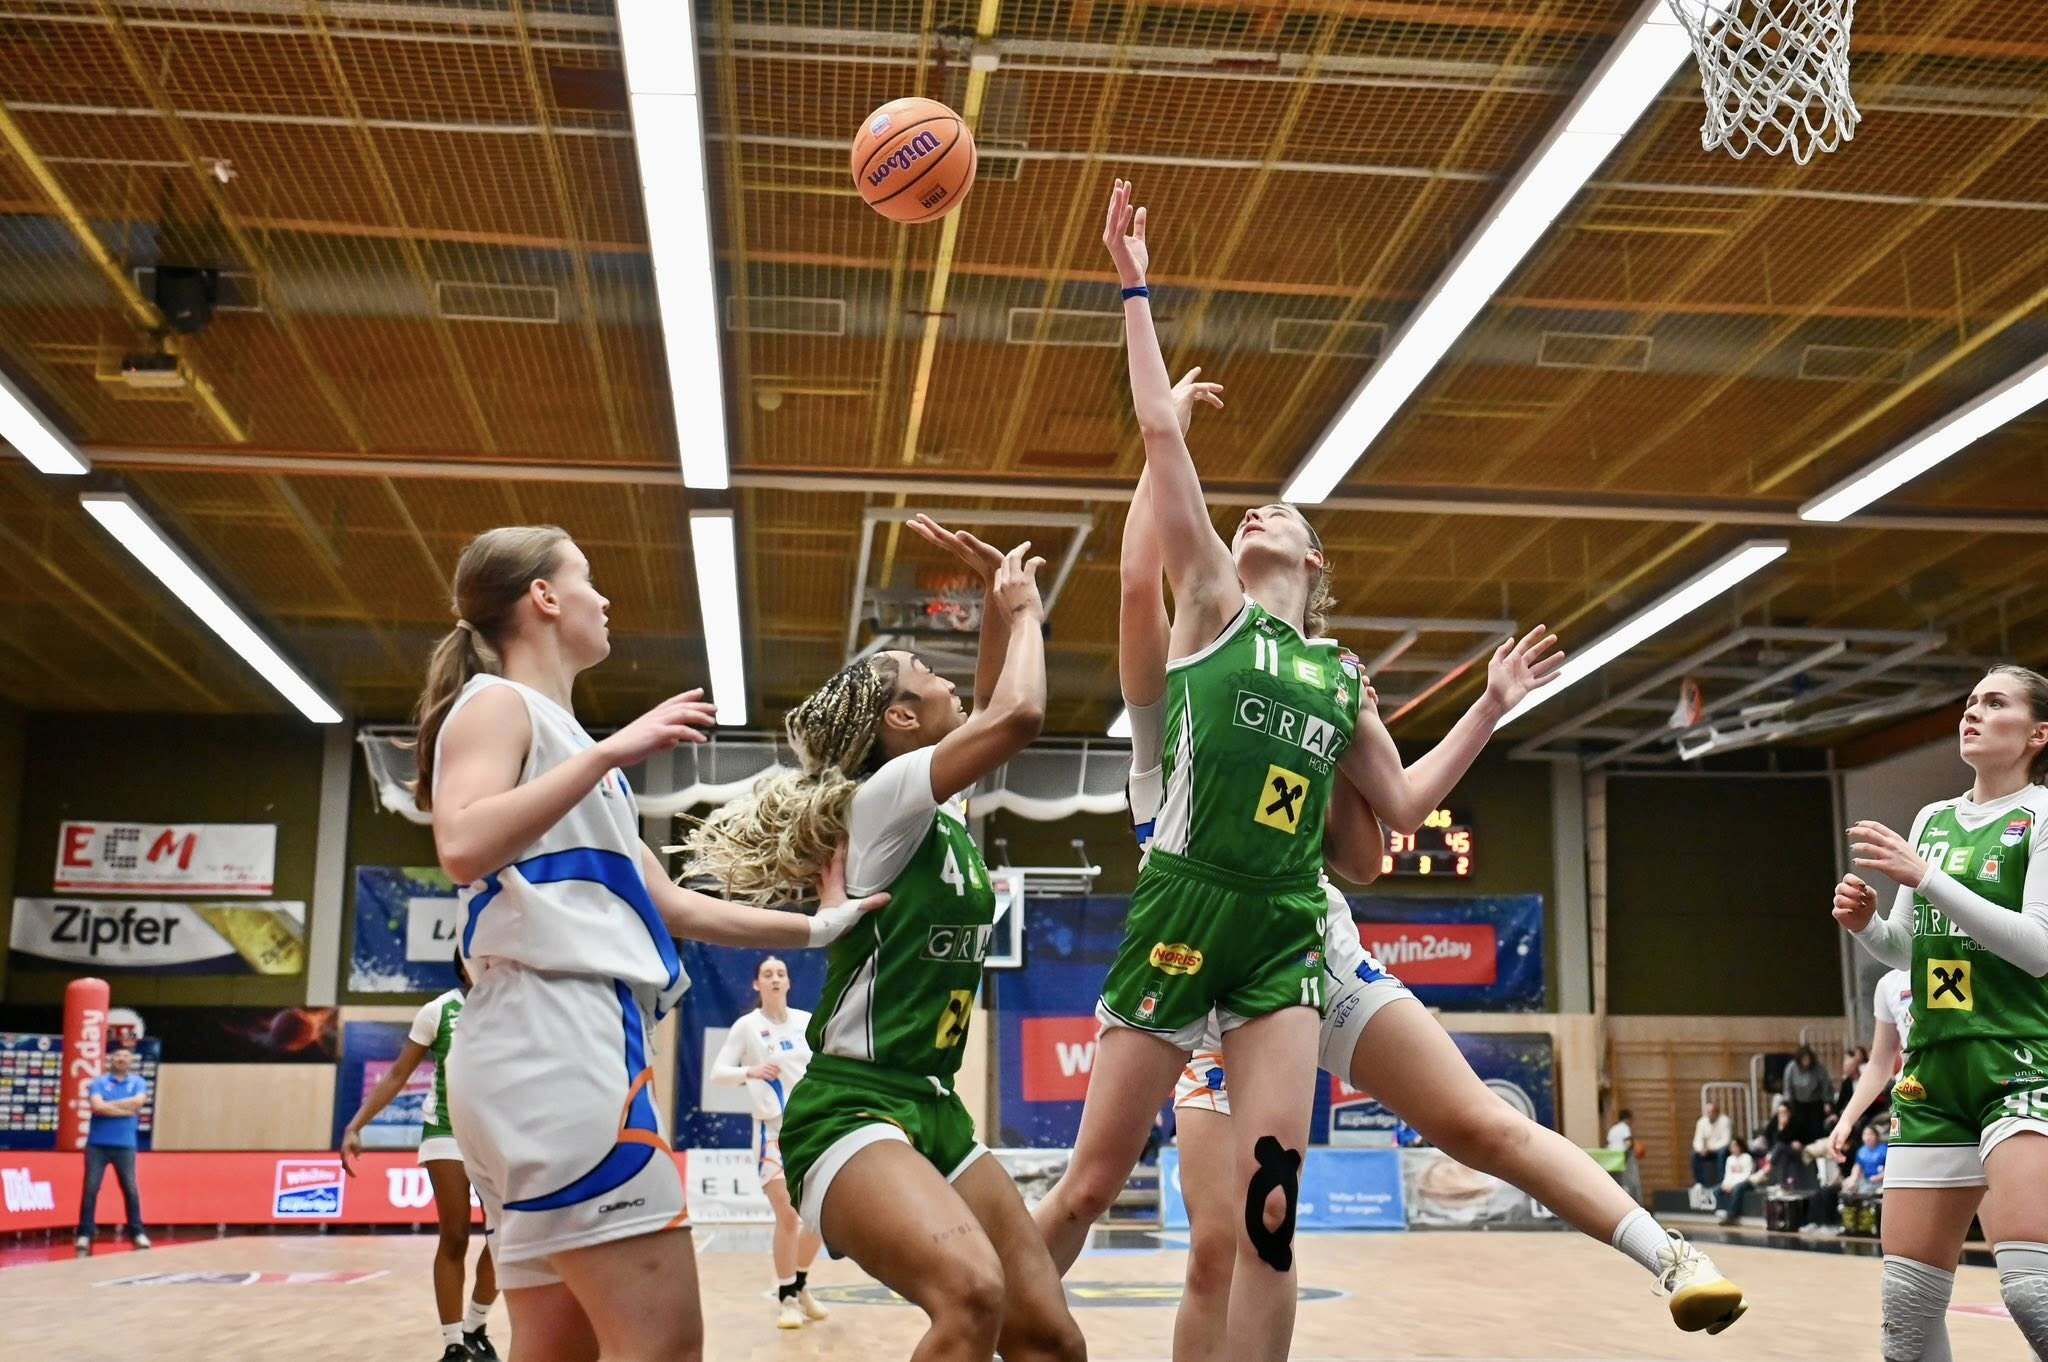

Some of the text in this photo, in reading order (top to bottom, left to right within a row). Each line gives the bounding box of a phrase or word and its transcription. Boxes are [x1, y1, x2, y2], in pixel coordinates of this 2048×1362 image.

[866, 130, 941, 188] Wilson
[920, 185, 948, 209] FIBA
[1254, 633, 1279, 677] 11
[1240, 697, 1344, 762] GRAZ
[1445, 831, 1470, 854] 45
[939, 843, 965, 897] 4
[1456, 856, 1469, 875] 2
[51, 904, 180, 956] Zipfer
[1154, 948, 1197, 967] NORIS
[1371, 934, 1472, 966] win2day
[1300, 976, 1320, 1007] 11
[1334, 997, 1360, 1028] WELS
